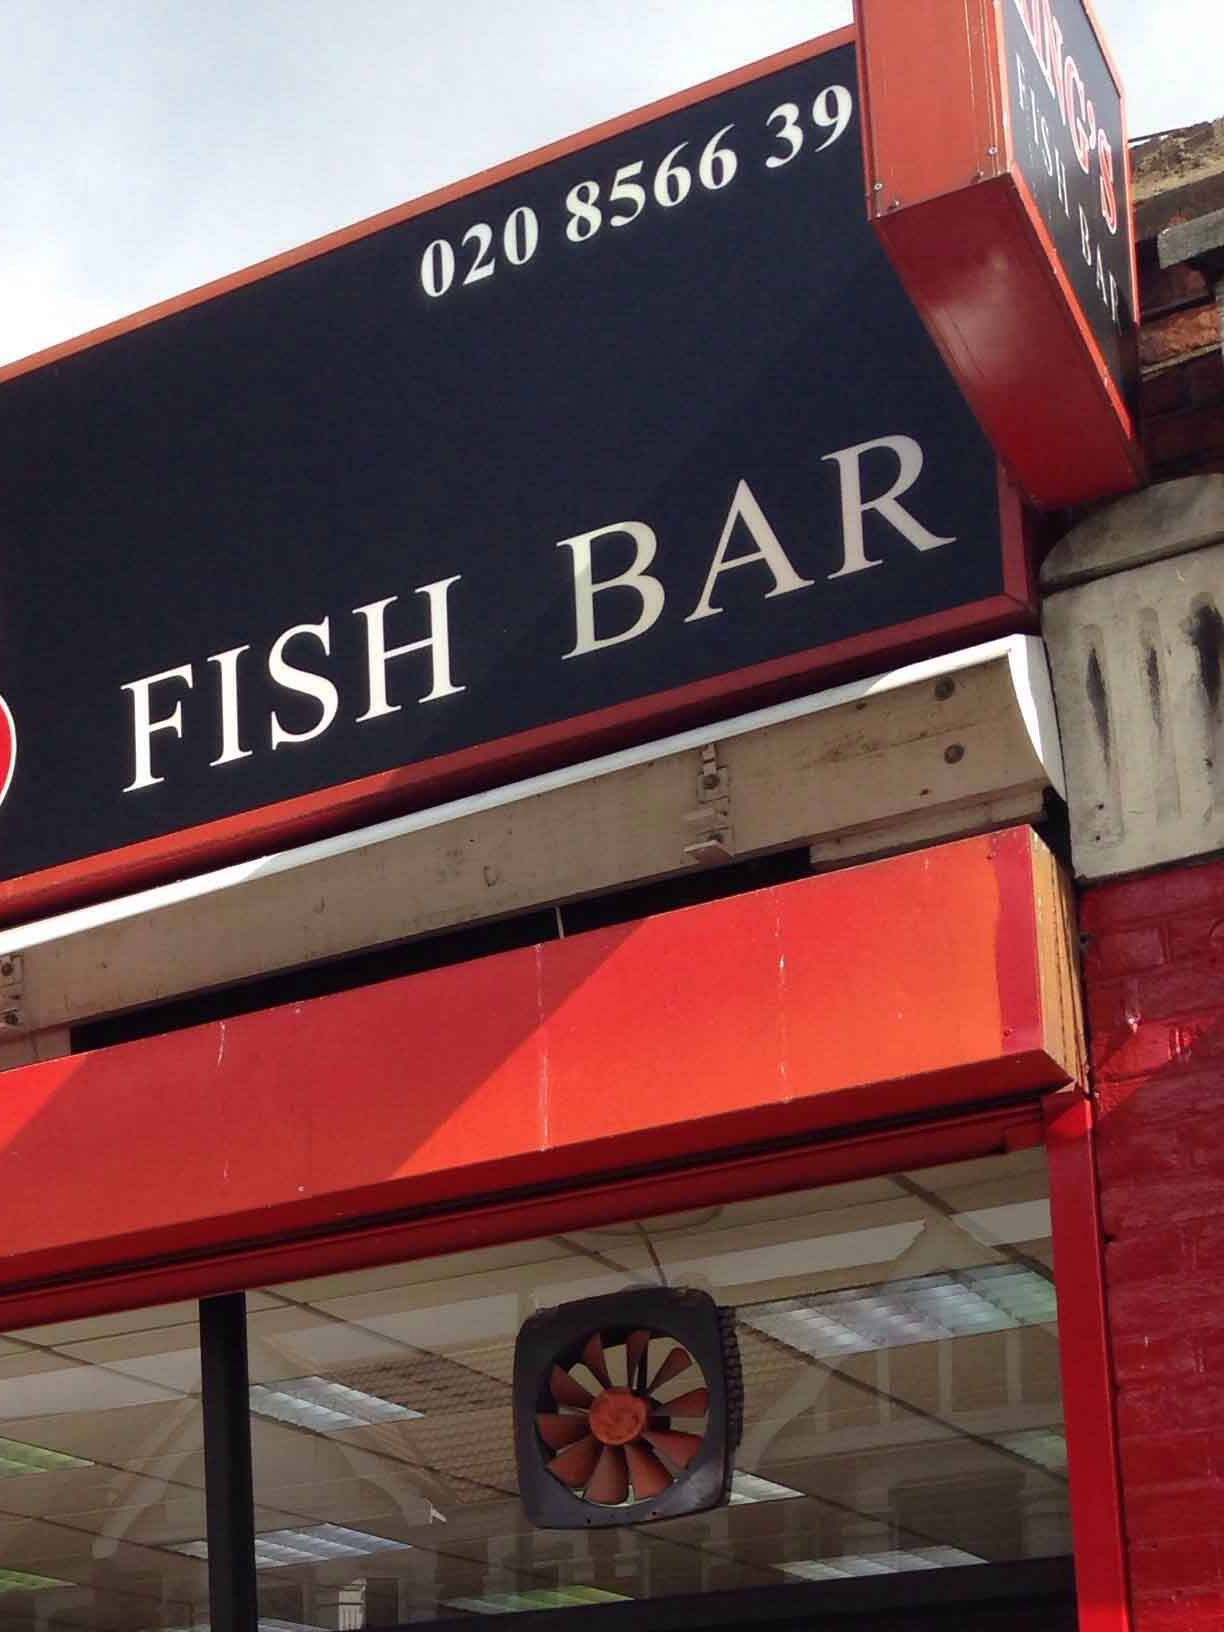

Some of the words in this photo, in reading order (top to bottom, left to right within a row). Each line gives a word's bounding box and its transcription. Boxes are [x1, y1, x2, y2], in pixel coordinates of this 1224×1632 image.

[419, 205, 539, 298] 020
[564, 122, 738, 243] 8566
[1015, 52, 1070, 218] FISH
[120, 574, 467, 793] FISH
[556, 434, 957, 661] BAR
